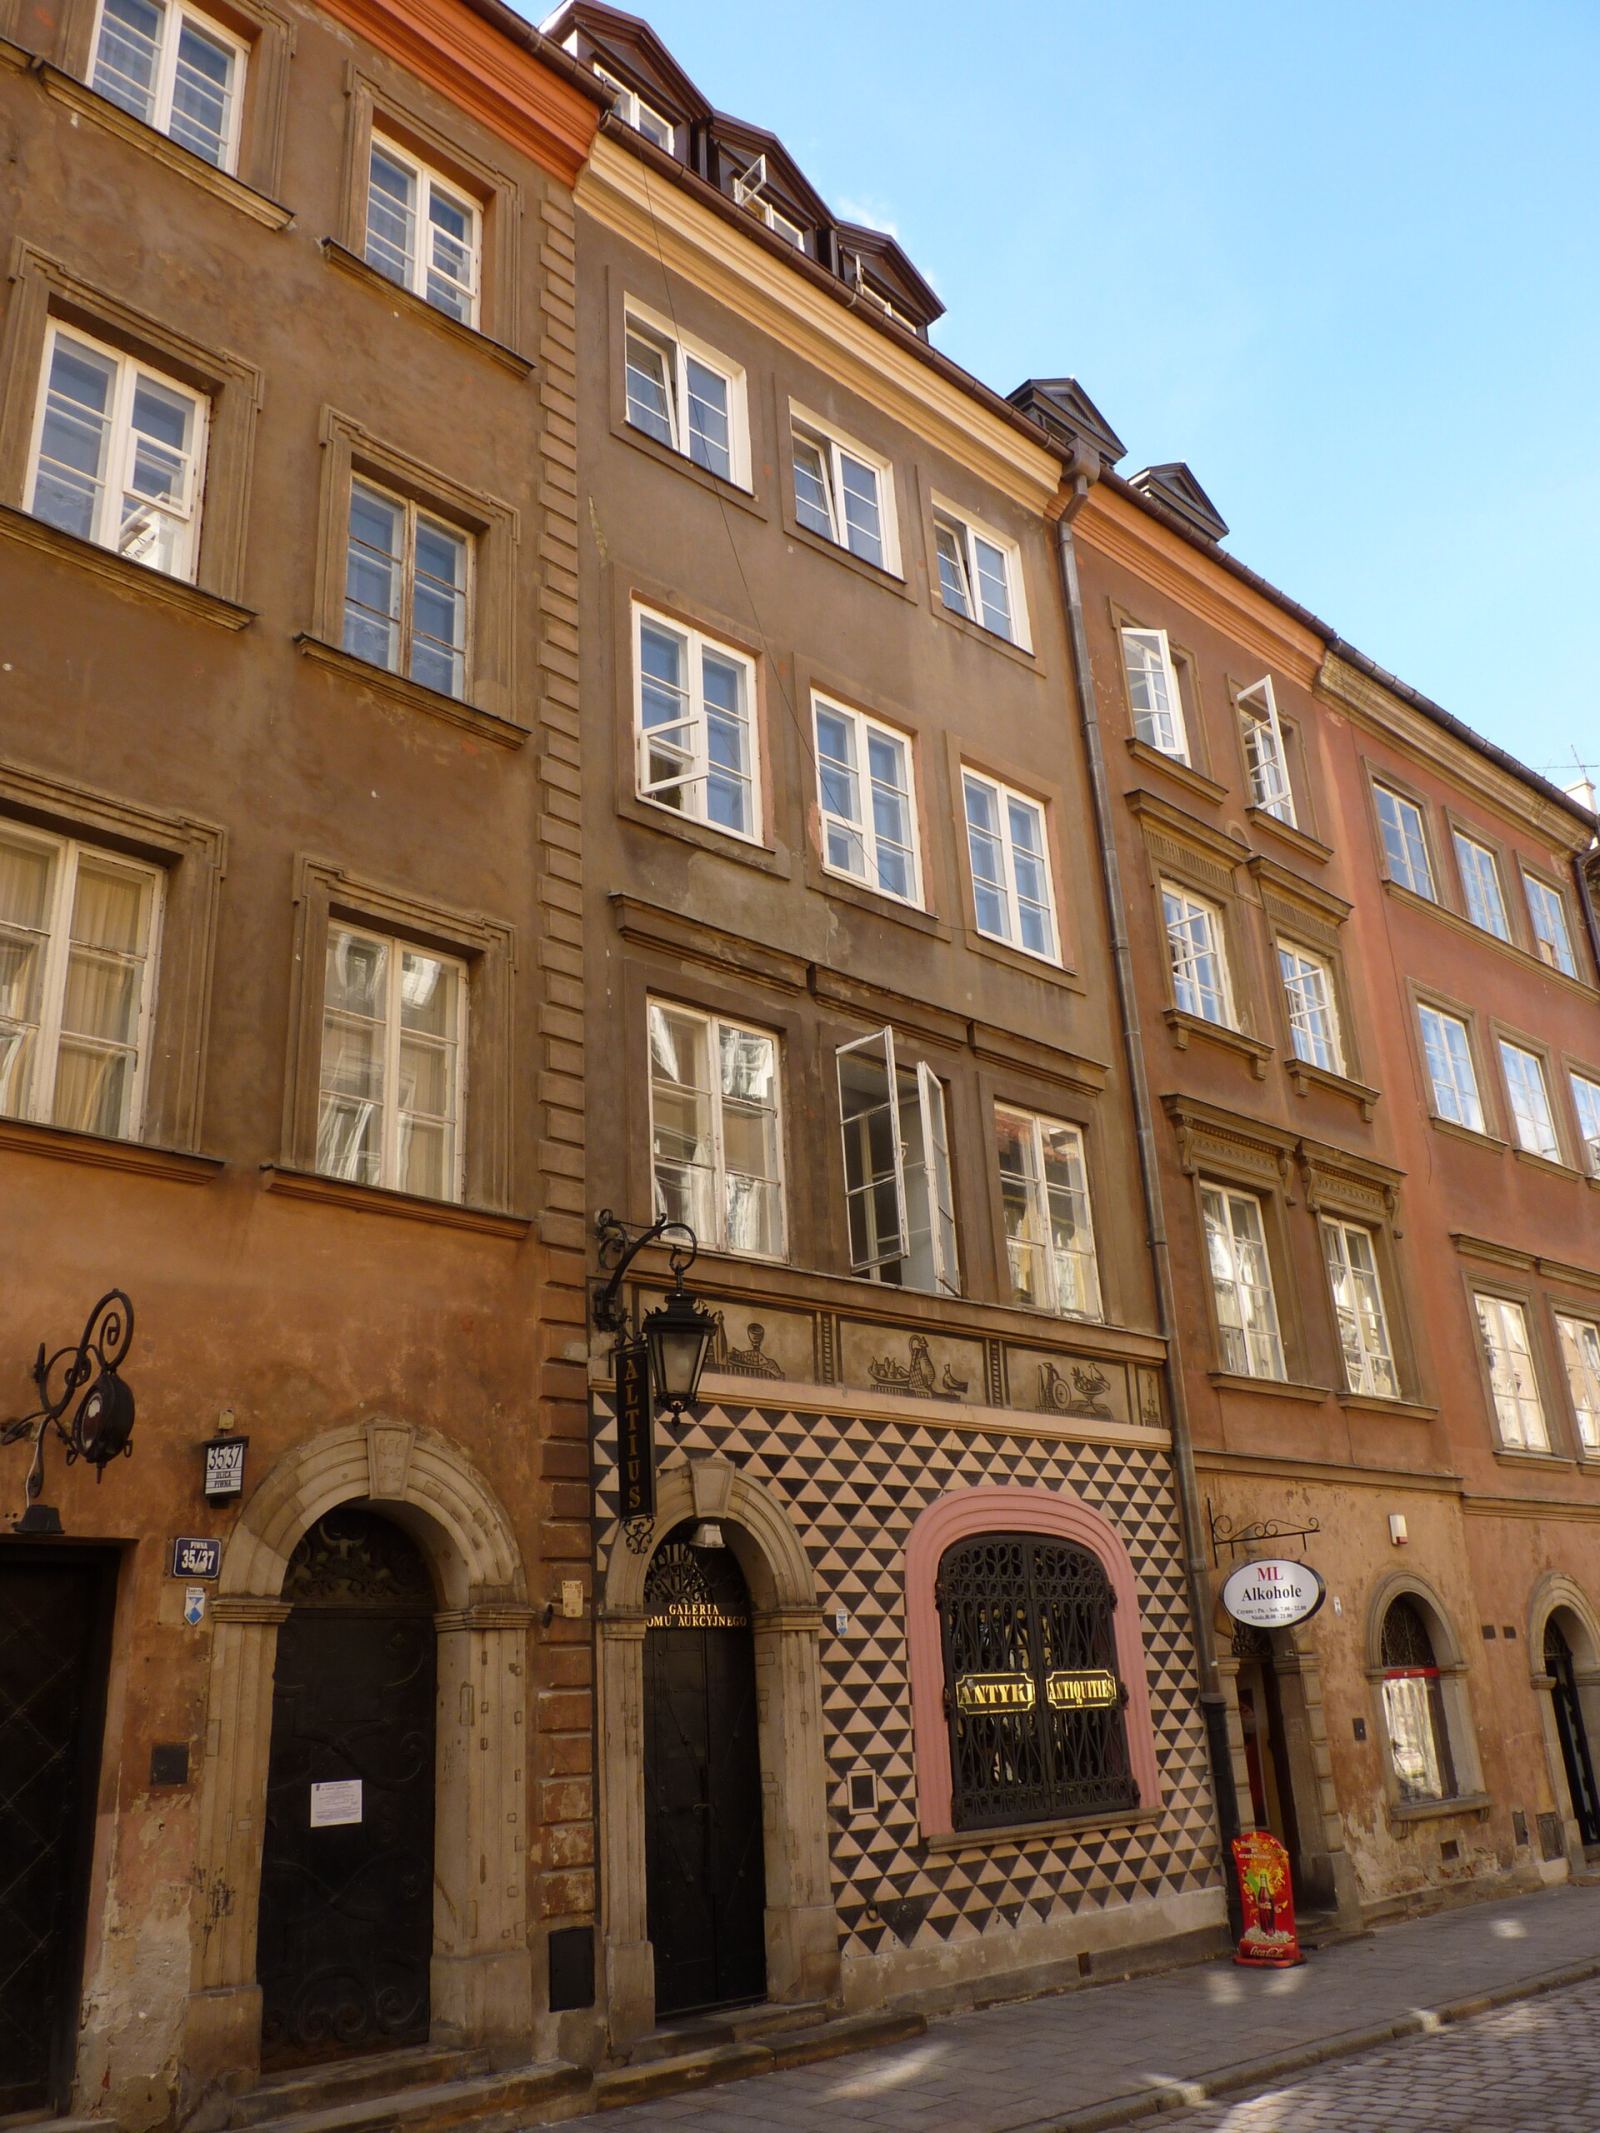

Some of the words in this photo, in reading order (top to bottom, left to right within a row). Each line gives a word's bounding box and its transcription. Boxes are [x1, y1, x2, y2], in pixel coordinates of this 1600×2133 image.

[624, 1359, 641, 1509] ALTIUS
[214, 1480, 232, 1488] PIWNA
[190, 1541, 208, 1549] PIWNA
[181, 1549, 215, 1571] 35/37
[1257, 1566, 1283, 1581] ML
[1241, 1585, 1302, 1602] Alkohole
[668, 1603, 720, 1615] GALERIA
[646, 1616, 672, 1627] OMU
[678, 1615, 748, 1627] AUKCYJNEGO
[959, 1683, 1033, 1704] ANTYKI
[1048, 1679, 1114, 1702] ANTIQUITIES
